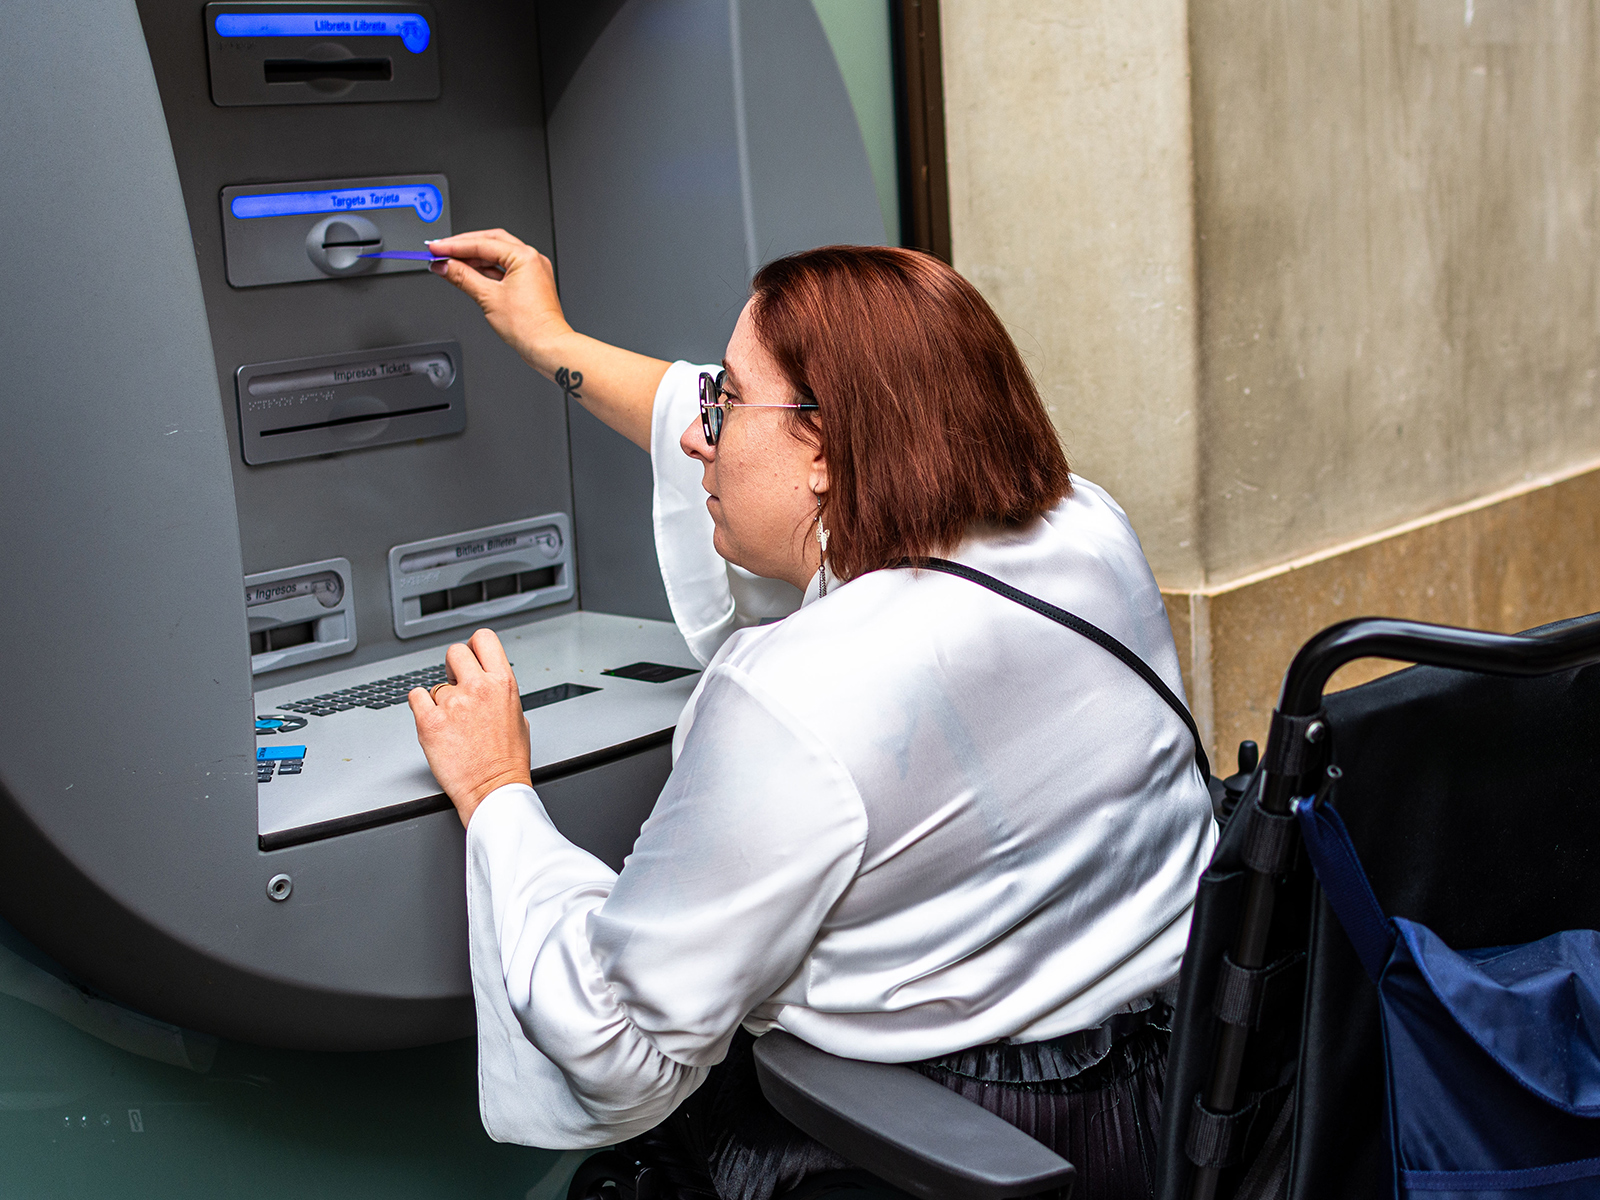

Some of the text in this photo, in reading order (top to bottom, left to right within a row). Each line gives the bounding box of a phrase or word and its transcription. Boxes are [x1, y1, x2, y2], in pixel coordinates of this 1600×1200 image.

[314, 19, 387, 32] Llibreta Libreta
[331, 193, 400, 209] Targeta Tarjeta
[334, 362, 411, 382] Impresos Tickets
[487, 537, 517, 551] Billetes
[255, 584, 297, 600] Ingresos
